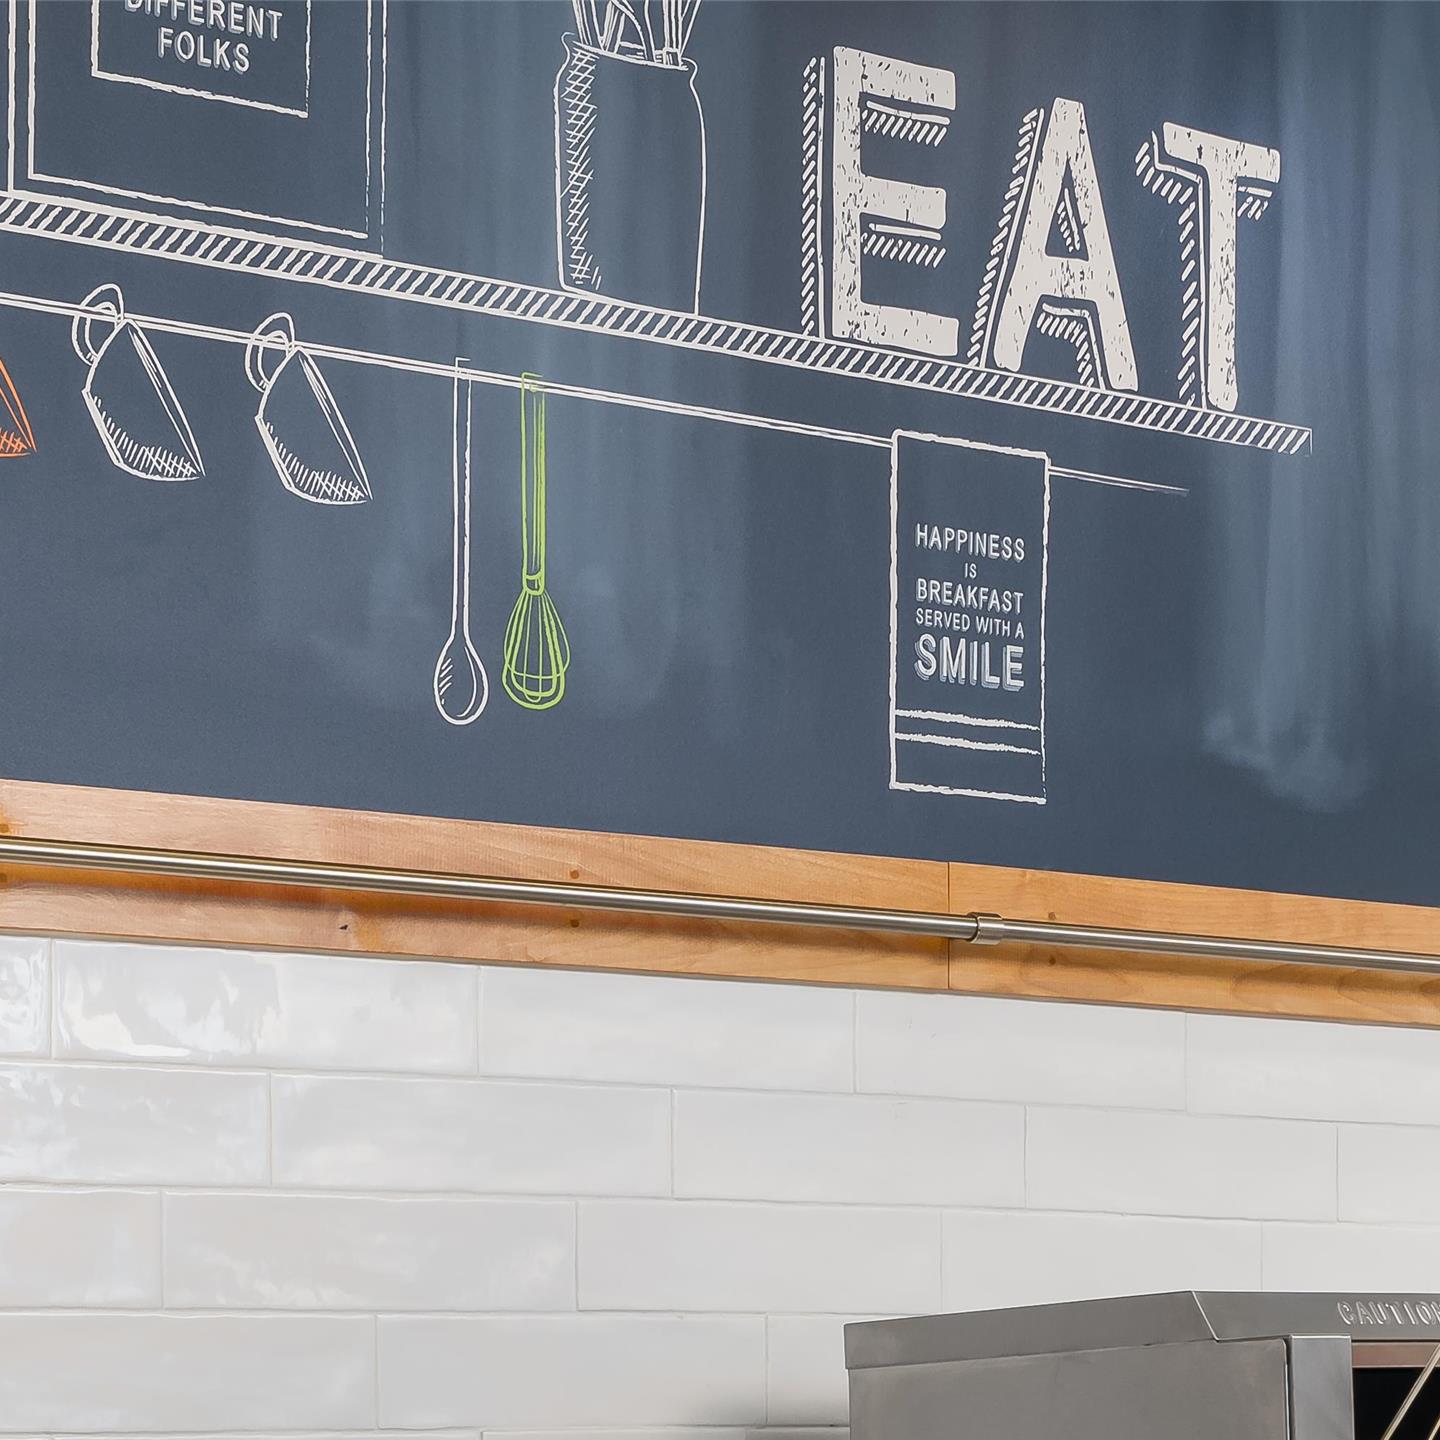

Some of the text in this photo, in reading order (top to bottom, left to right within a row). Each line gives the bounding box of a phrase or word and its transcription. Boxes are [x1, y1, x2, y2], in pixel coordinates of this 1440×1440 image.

[157, 26, 250, 75] FOLKS
[803, 46, 1281, 412] EAT
[915, 523, 1026, 562] HAPPINESS
[964, 562, 978, 579] IS
[915, 577, 1025, 615] BREAKFAST
[915, 607, 1025, 640] SERVED WITH A
[914, 633, 1025, 692] SMILE
